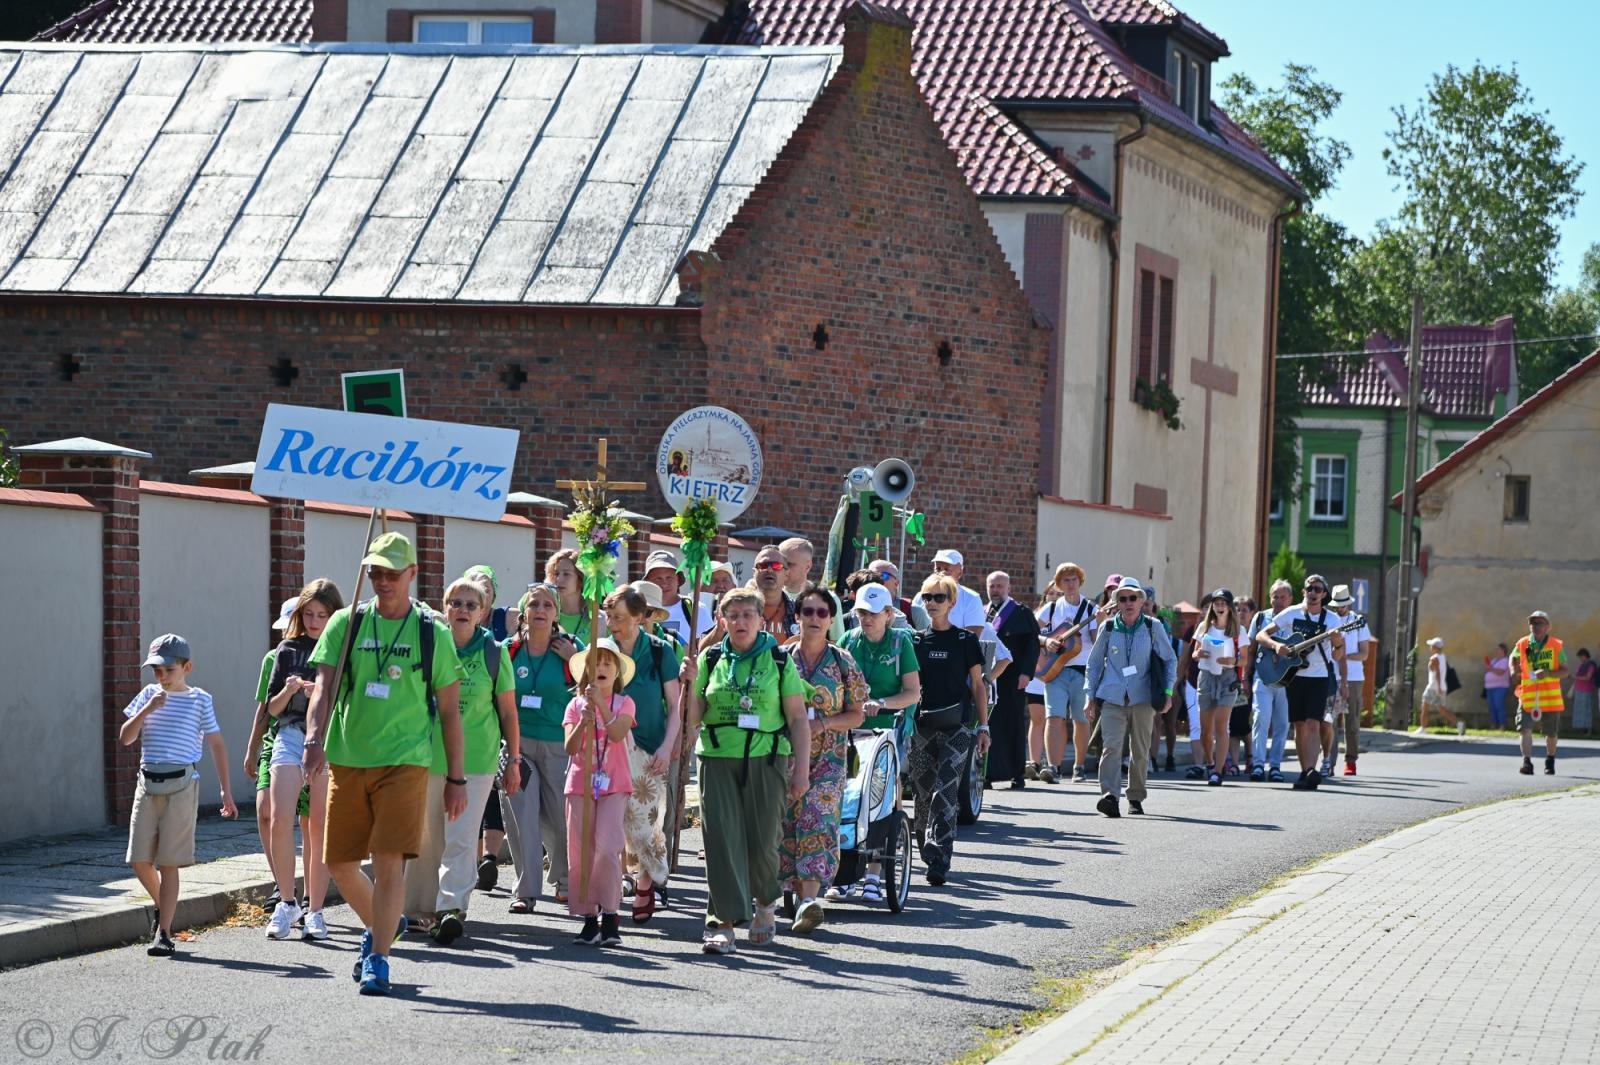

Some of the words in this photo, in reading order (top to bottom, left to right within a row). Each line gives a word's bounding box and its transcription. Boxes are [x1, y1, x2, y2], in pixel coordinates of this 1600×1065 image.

[263, 428, 506, 500] Racibórz
[659, 433, 675, 474] OPOLSKA
[672, 410, 729, 432] PIELGRZYMKA
[731, 418, 742, 432] NA
[670, 476, 744, 504] KIETRZ
[868, 495, 884, 522] 5
